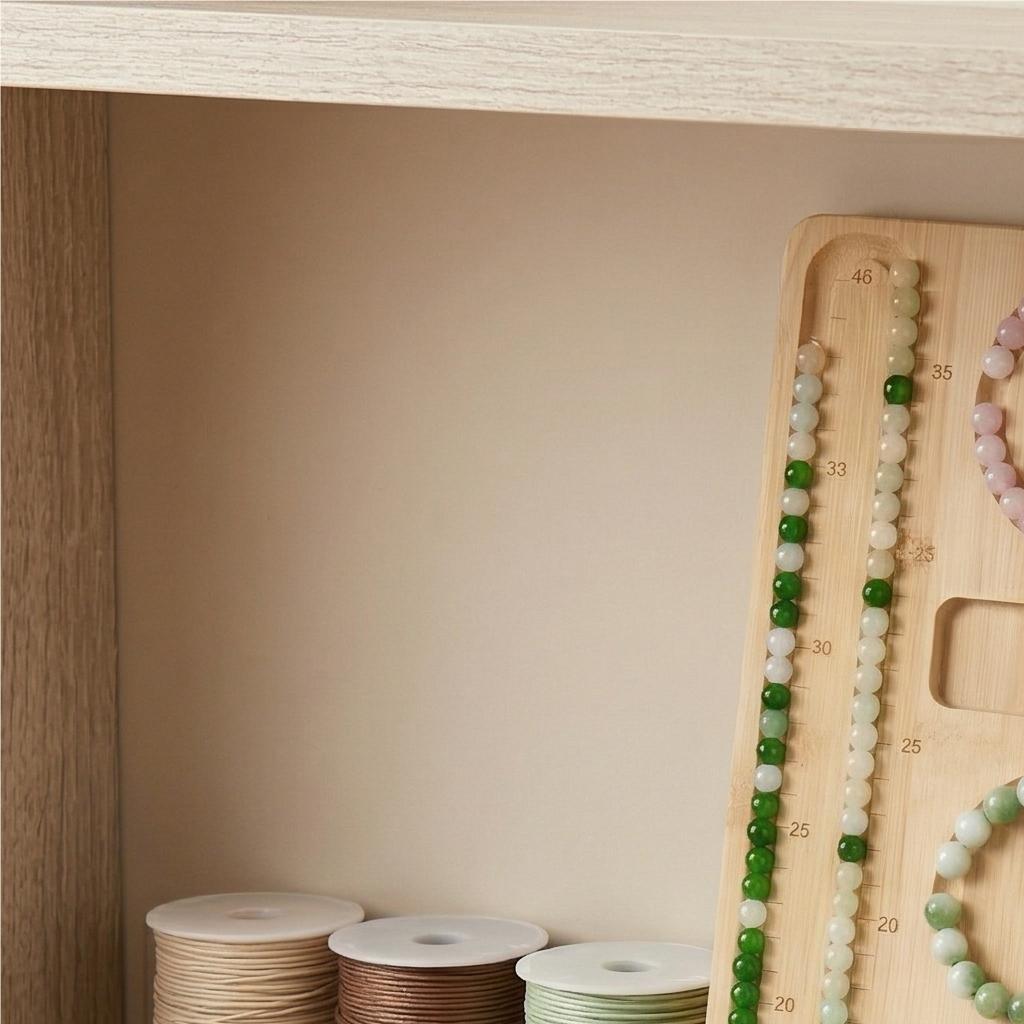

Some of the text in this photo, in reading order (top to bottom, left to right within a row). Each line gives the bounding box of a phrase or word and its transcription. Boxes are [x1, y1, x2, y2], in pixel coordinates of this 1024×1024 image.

[851, 268, 872, 285] 46
[931, 363, 953, 380] 35
[826, 461, 847, 477] 33
[811, 640, 832, 656] 30
[901, 738, 922, 755] 25
[789, 821, 810, 838] 25
[877, 916, 899, 933] 20
[773, 996, 795, 1013] 20
